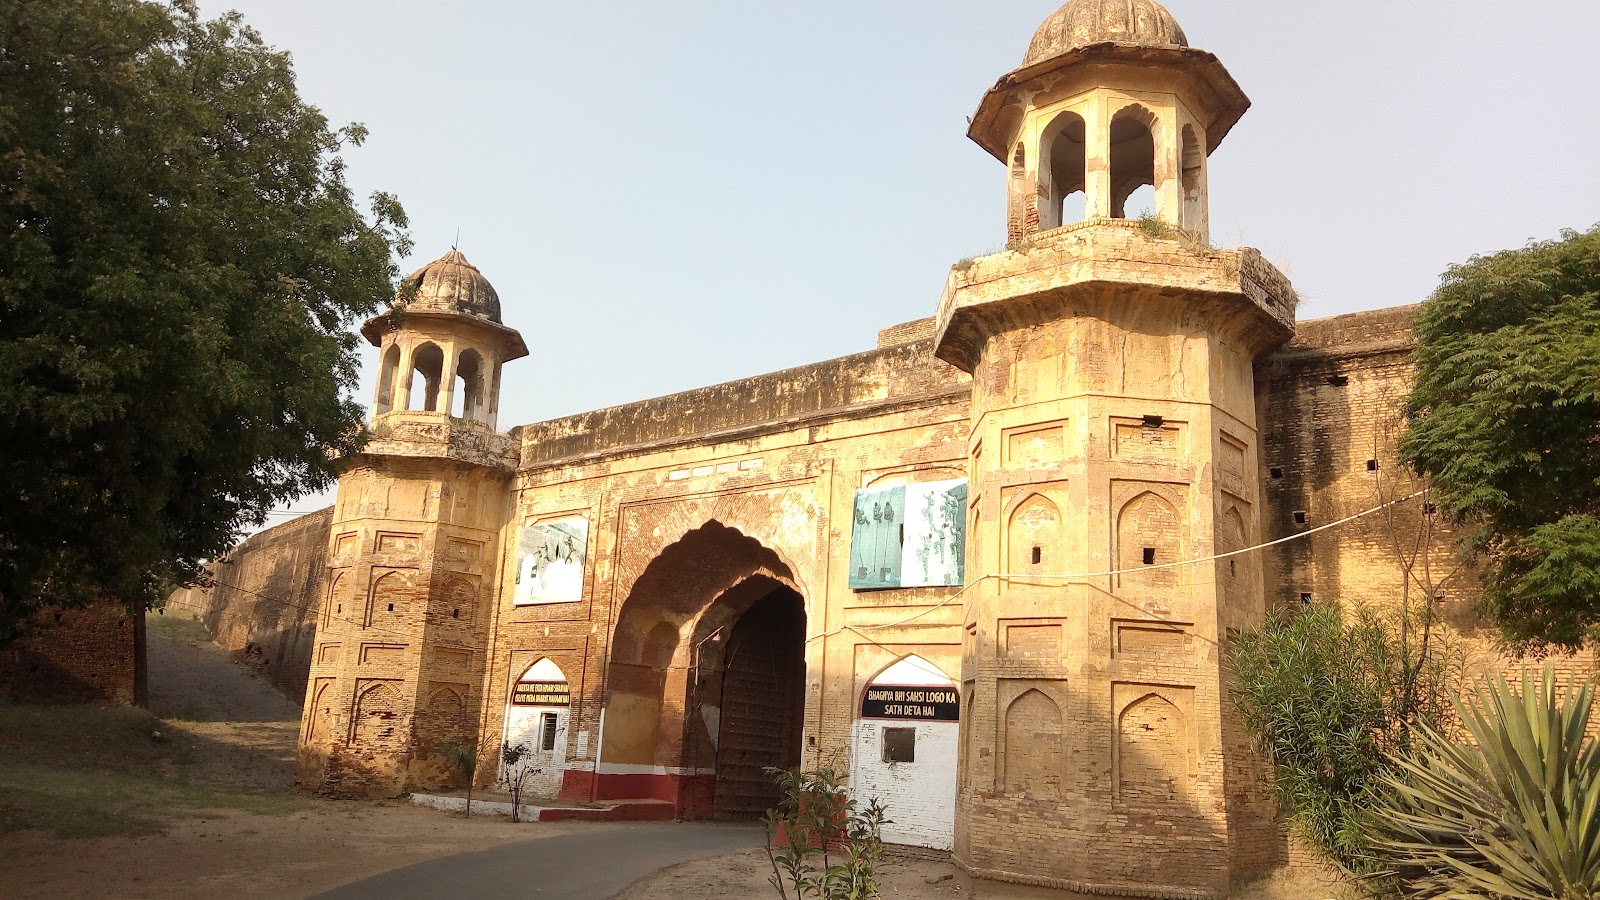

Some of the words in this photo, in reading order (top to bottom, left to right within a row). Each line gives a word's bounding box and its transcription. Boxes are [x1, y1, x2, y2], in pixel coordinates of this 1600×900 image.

[895, 691, 905, 701] BHI
[906, 691, 924, 702] SAHSI
[926, 692, 945, 703] LOGO
[946, 692, 956, 703] KA
[885, 705, 902, 715] SATH
[904, 705, 921, 716] DETA
[923, 706, 934, 716] HAI
